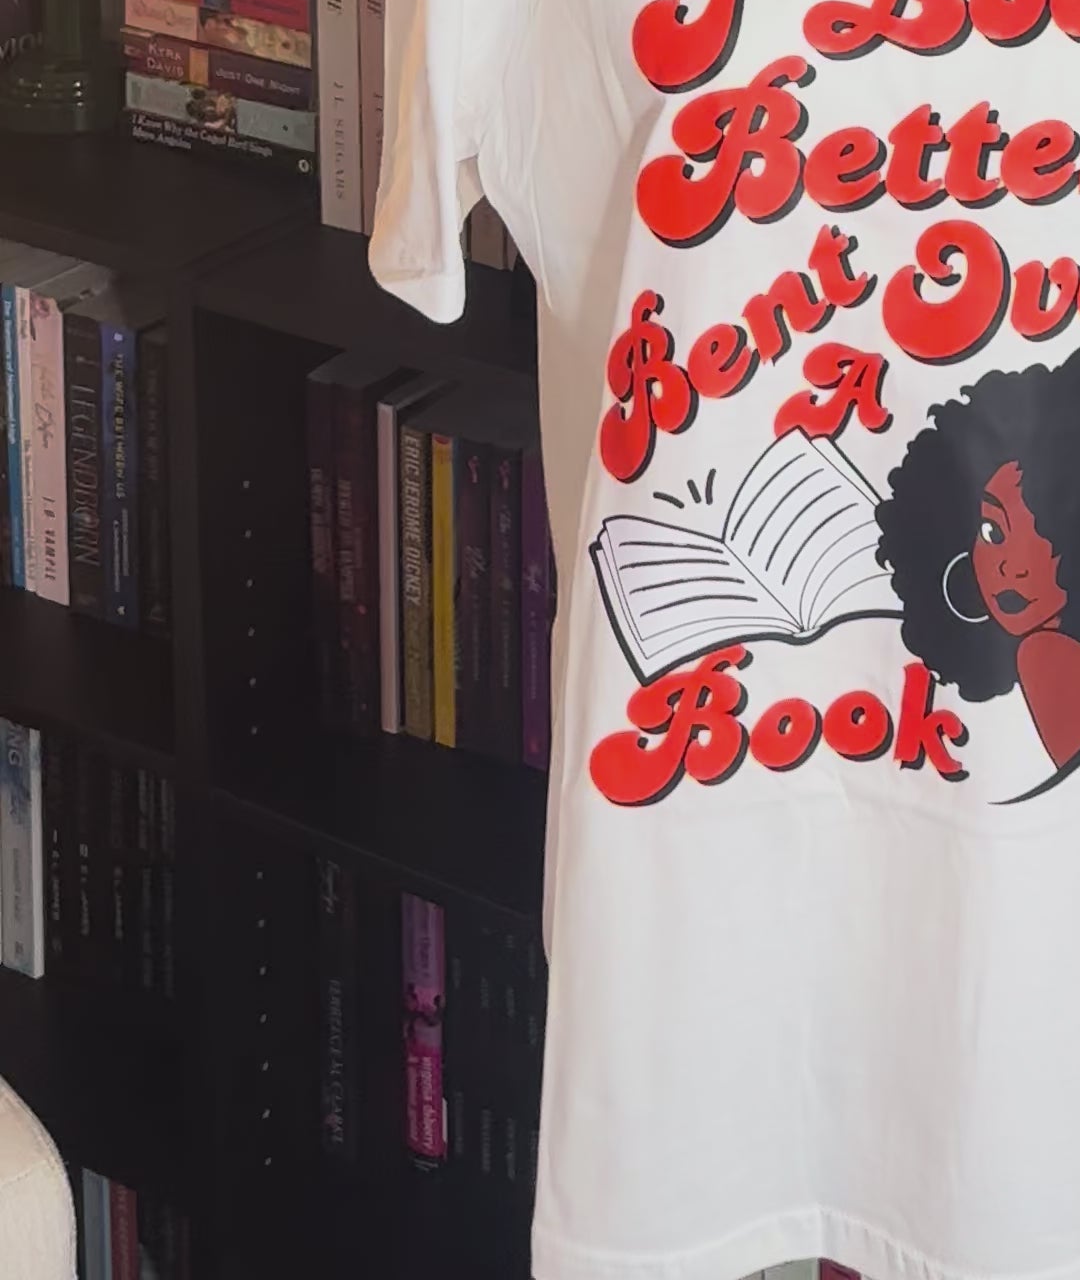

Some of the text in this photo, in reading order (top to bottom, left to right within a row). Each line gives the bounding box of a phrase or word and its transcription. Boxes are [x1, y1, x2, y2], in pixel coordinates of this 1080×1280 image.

[147, 56, 185, 77] DAVIS
[148, 43, 183, 62] KYRA
[216, 67, 241, 82] JUST
[600, 223, 878, 484] Bent
[774, 342, 894, 441] A
[70, 384, 103, 566] LEGENDBORN
[403, 435, 420, 474] ERIC
[404, 479, 421, 542] JEROME
[404, 545, 422, 607] DICKEY
[589, 644, 971, 810] Book
